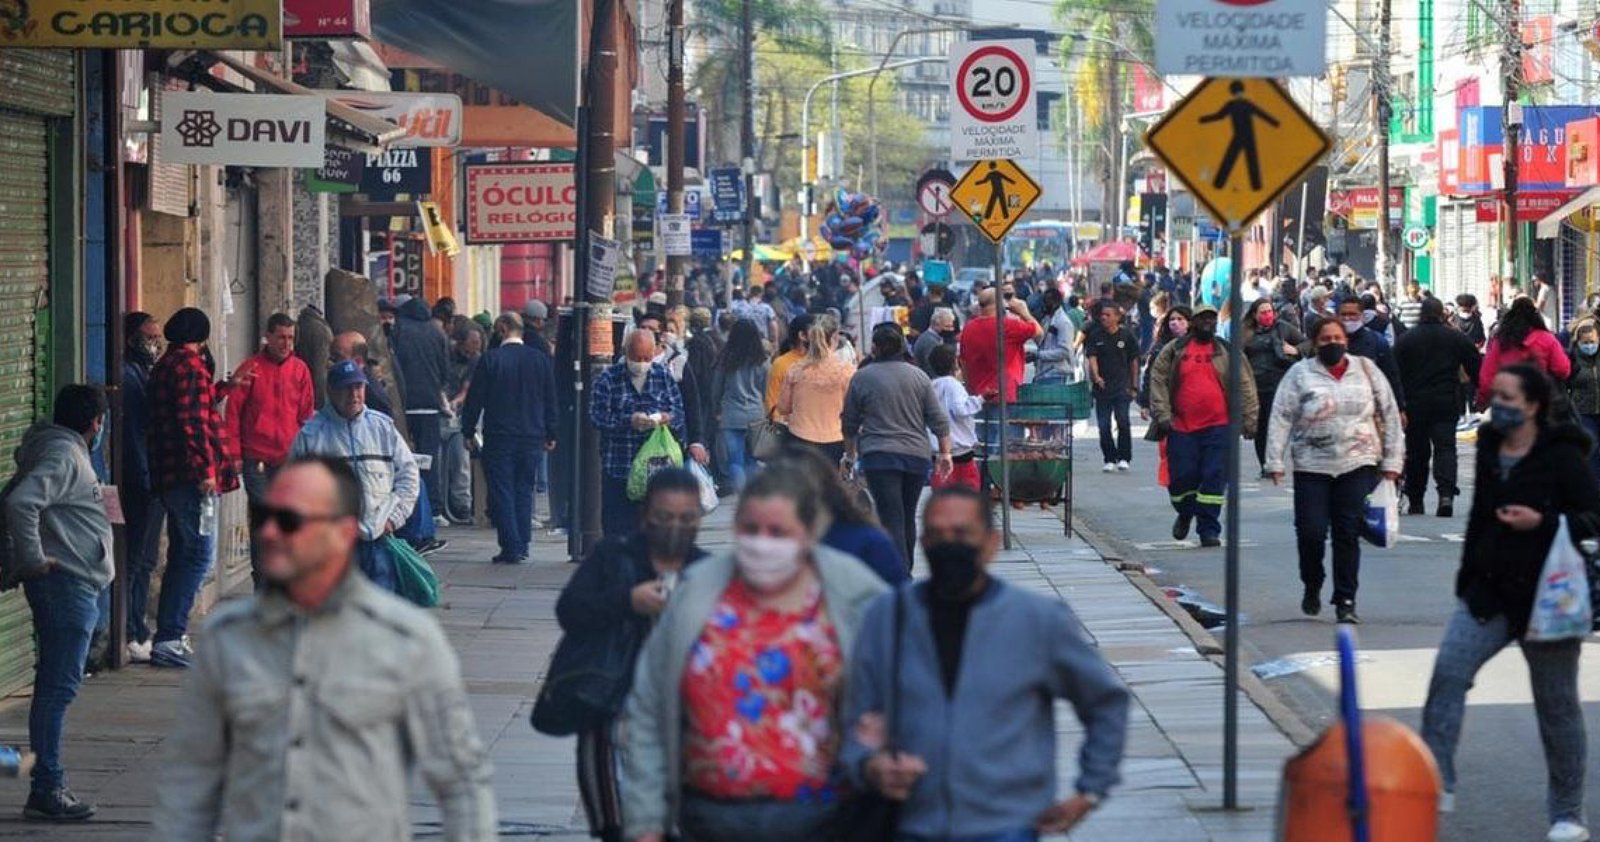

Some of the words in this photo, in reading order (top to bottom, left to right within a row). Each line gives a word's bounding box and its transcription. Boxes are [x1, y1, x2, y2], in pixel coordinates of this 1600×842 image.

[51, 11, 268, 38] CARIOCA
[333, 17, 347, 26] 44
[1184, 55, 1295, 71] PERMITIDA
[972, 66, 1015, 97] 20
[227, 118, 312, 144] DAVI
[365, 150, 418, 168] PIAZZA
[966, 147, 1022, 158] PERMITIDA
[382, 168, 402, 183] 66
